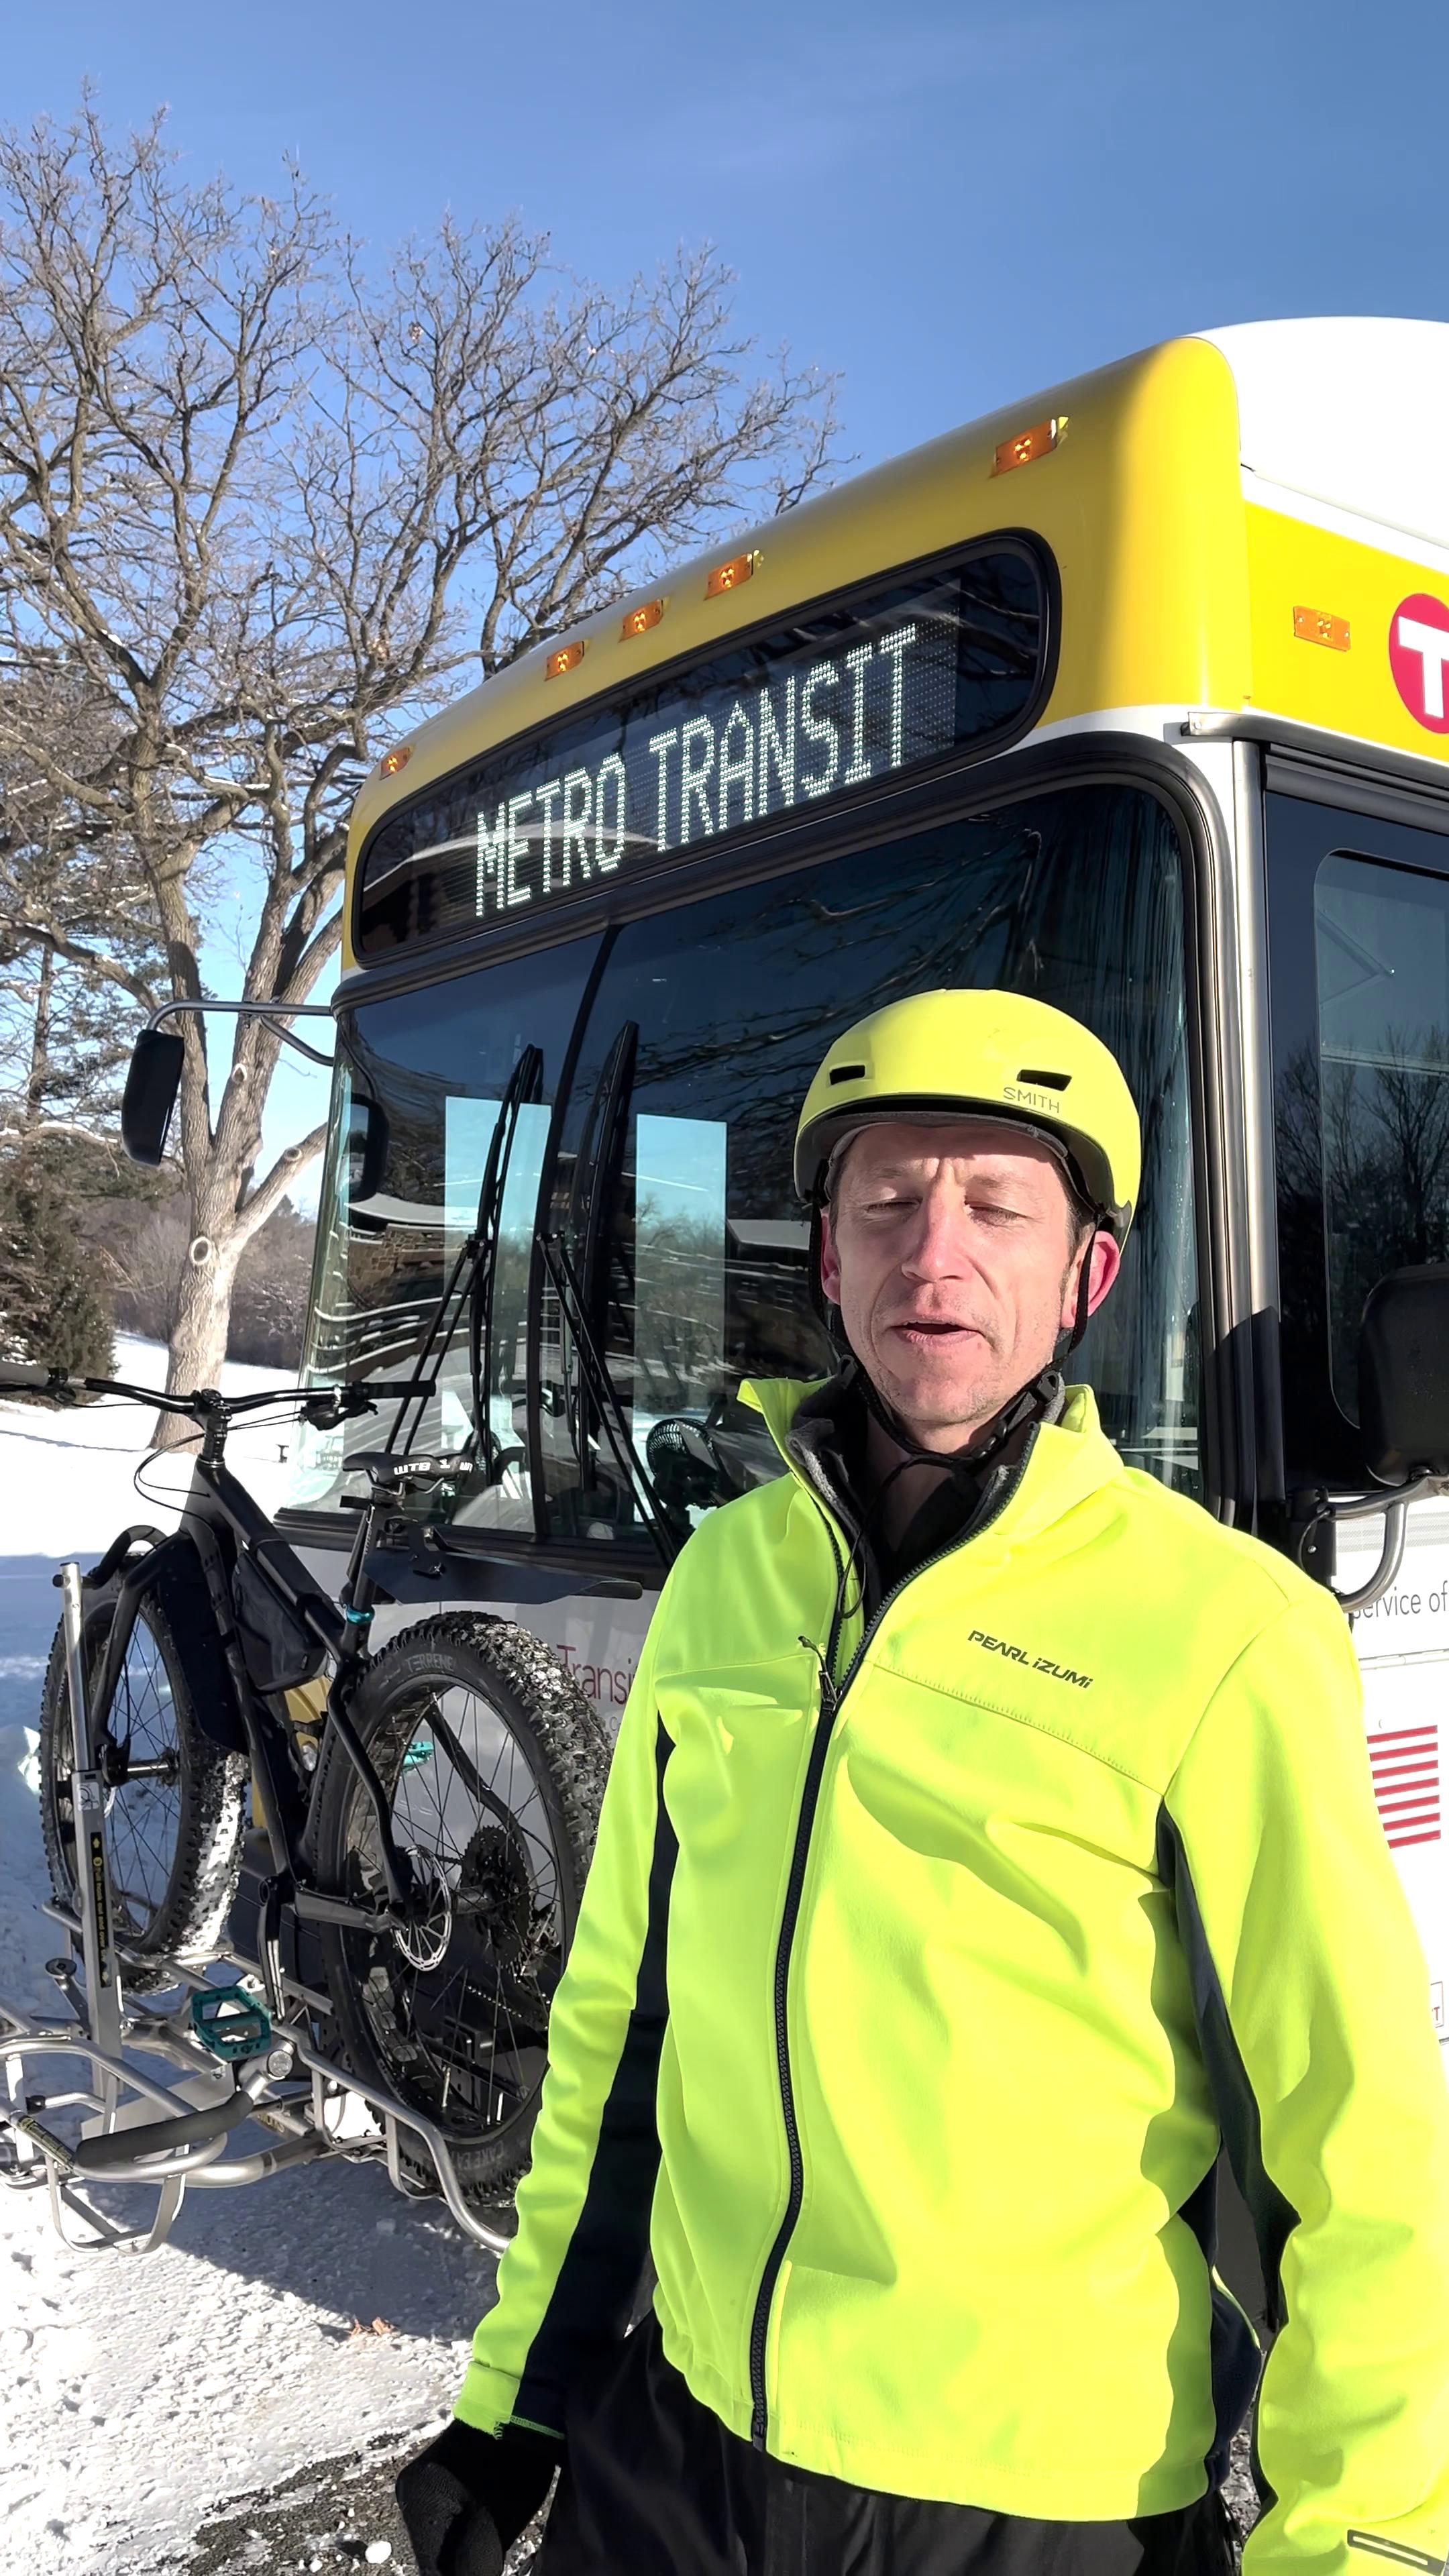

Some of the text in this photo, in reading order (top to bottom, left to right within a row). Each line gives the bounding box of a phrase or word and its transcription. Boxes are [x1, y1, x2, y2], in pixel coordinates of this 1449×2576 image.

[1398, 615, 1449, 719] T
[475, 623, 916, 917] METRO TRANSIT
[1003, 1087, 1059, 1114] SMITH
[393, 1462, 431, 1475] WTB
[1429, 1580, 1448, 1613] of
[405, 1653, 454, 1673] TERRENE
[967, 1629, 1030, 1666] PEARL
[557, 1644, 639, 1705] Transi
